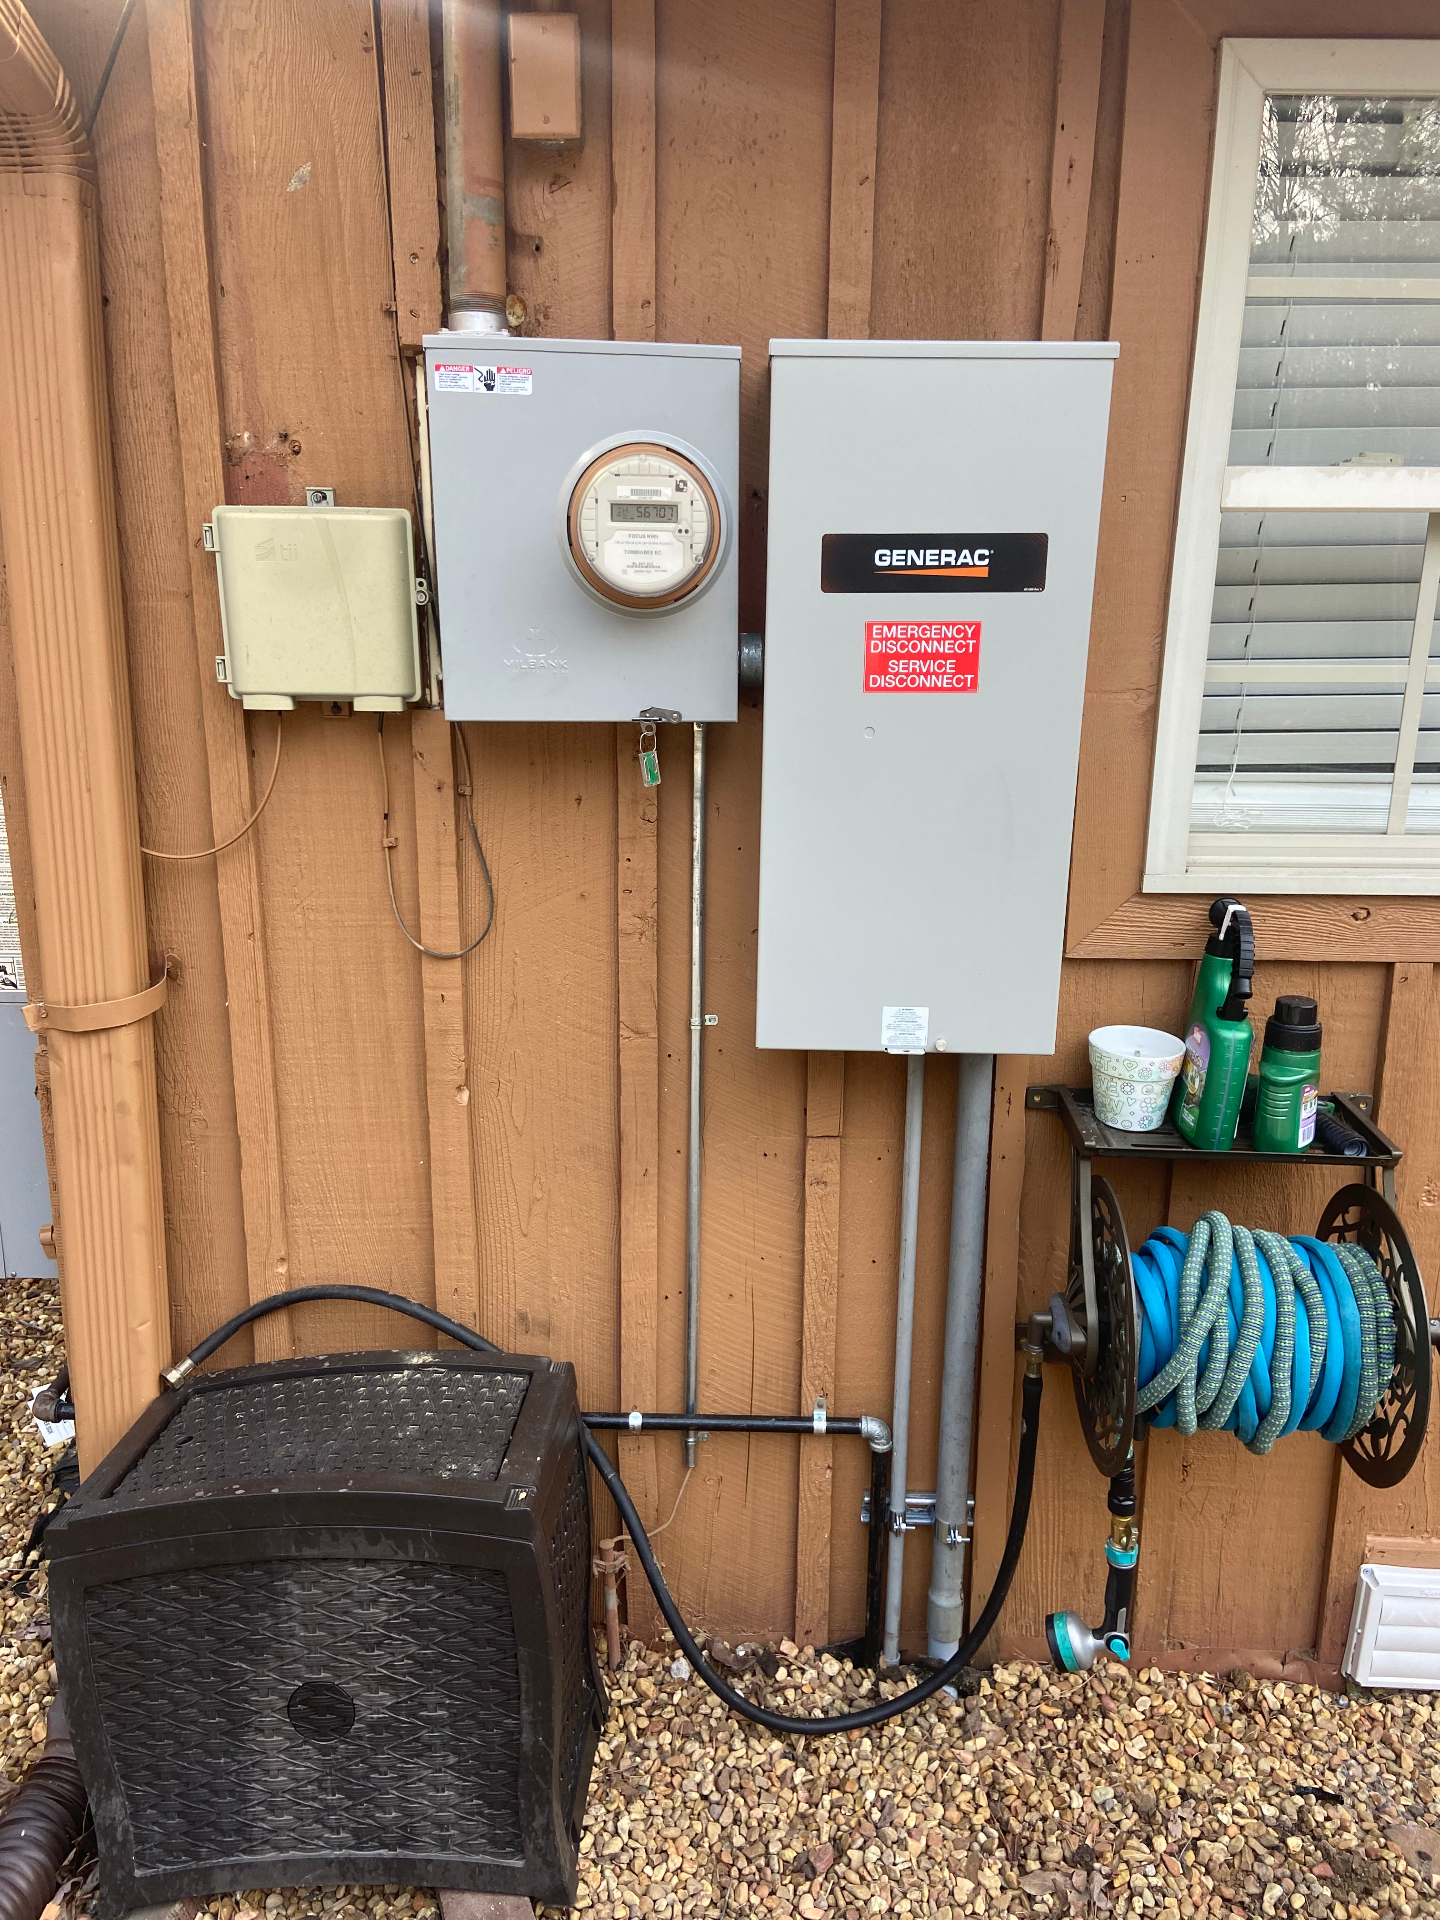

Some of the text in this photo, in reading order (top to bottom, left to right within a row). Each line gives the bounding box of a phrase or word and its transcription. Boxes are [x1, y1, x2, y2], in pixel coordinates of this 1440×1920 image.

[506, 367, 531, 375] PELIGRO
[874, 549, 990, 567] GENERAC
[872, 625, 976, 638] EMERGENCY
[870, 640, 977, 653] DISCONNECT
[888, 660, 957, 673] SERVICE
[869, 675, 975, 688] DISCONNECT
